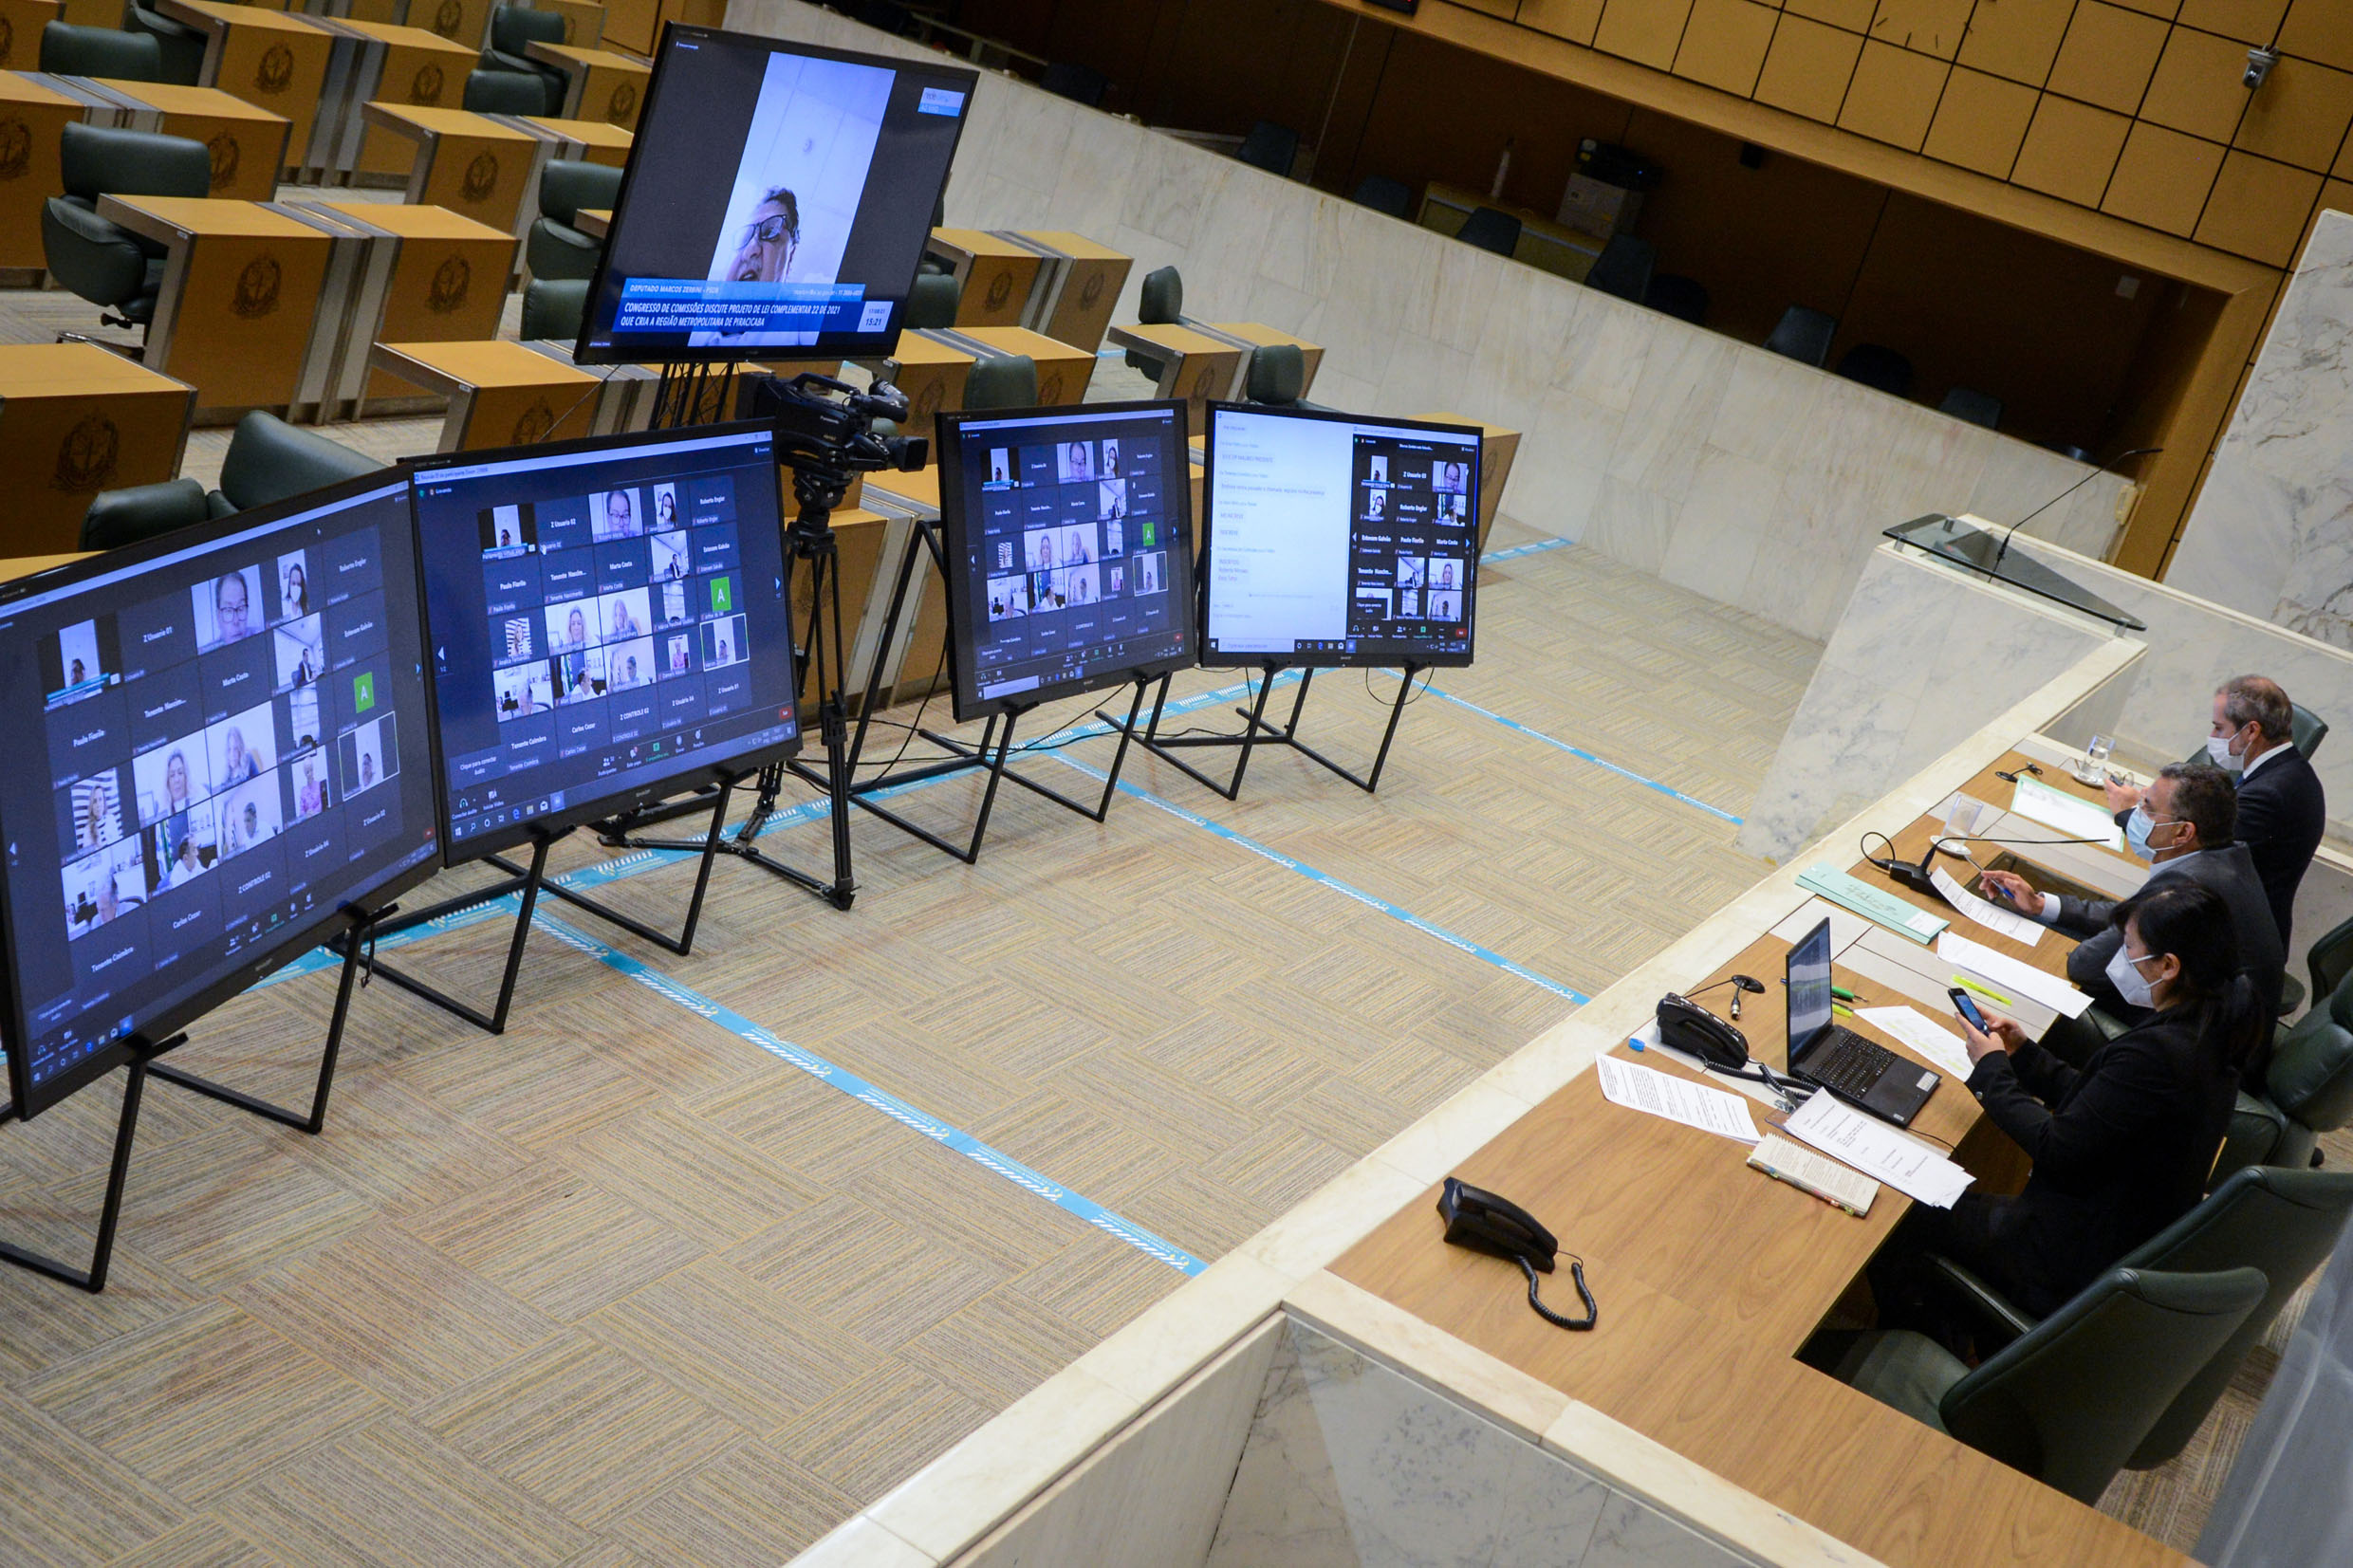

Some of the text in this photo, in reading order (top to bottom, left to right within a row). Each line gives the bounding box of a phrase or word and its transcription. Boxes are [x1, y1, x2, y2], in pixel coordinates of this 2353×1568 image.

[624, 302, 841, 315] CONGRESSO DE COMISSÕES DISCUTE PROJETO DE LEI COMPLEMENTAR 22 DE 2021
[621, 315, 765, 327] QUE CRIA A REGIÃO METROPOLITANA DE PIRACICABA
[865, 318, 882, 326] 15:21
[1146, 529, 1152, 540] A
[717, 588, 725, 603] A
[360, 685, 368, 701] A
[511, 740, 528, 750] Tenente
